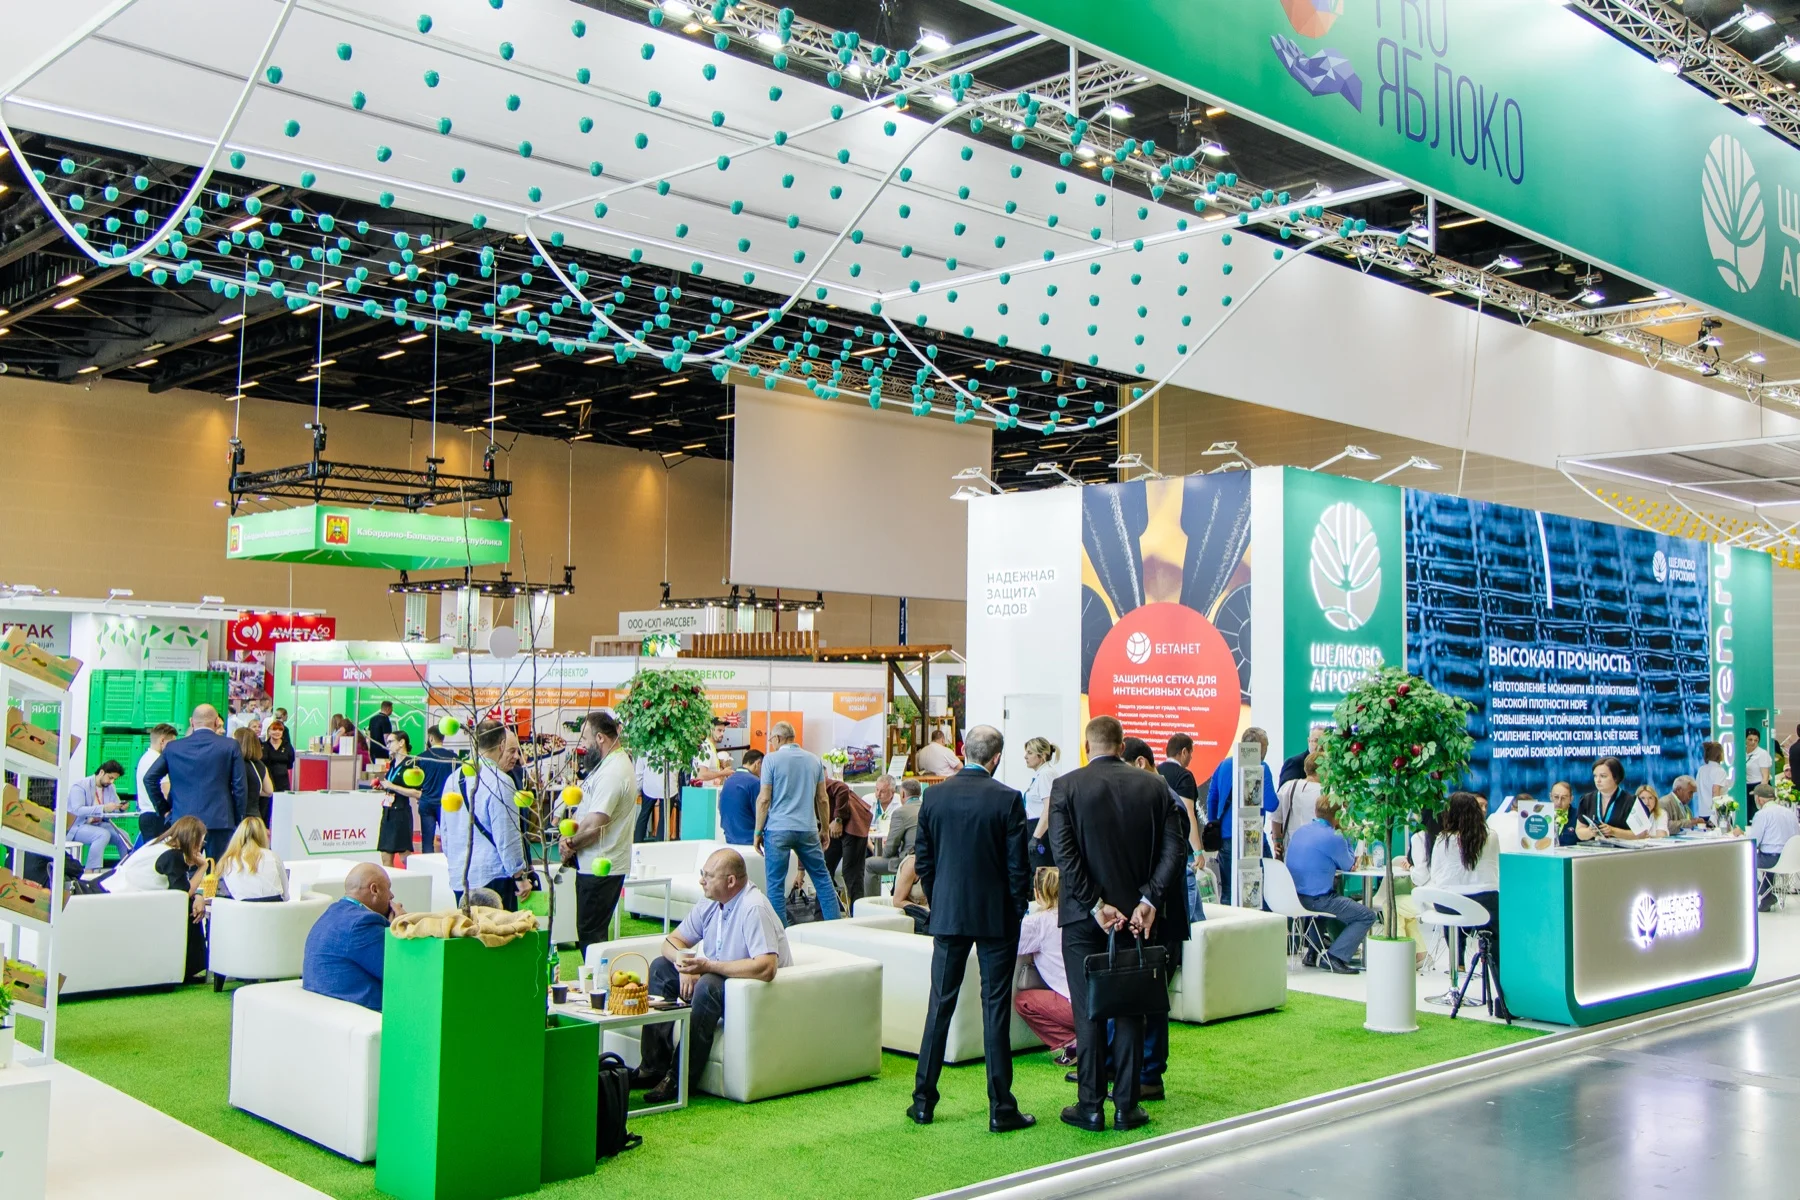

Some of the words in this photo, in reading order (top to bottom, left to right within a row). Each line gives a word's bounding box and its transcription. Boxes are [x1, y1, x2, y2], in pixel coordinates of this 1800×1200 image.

[1377, 37, 1524, 185] ЯБЛОКО
[1777, 184, 1800, 244] Щ
[357, 527, 454, 543] Кабардино-Балкарская
[987, 569, 1055, 584] НАДЕЖНАЯ
[986, 586, 1037, 601] ЗАЩИТА
[986, 603, 1028, 617] САДОВ
[1155, 643, 1201, 655] БЕТАНЕТ
[1311, 643, 1382, 667] ЩЕЛКОВО
[1489, 645, 1555, 669] ВЫСОКАЯ
[1558, 650, 1631, 673] ПРОЧНОСТЬ
[691, 670, 736, 680] ОВЕКТОР
[1112, 674, 1163, 686] ЗАЩИТНАЯ
[1165, 675, 1194, 685] СЕТКА
[1196, 676, 1217, 687] ДЛЯ
[1112, 686, 1181, 697] ИНТЕНСИВНЫХ
[1183, 687, 1217, 699] САДОВ
[1493, 681, 1546, 693] ИЗГОТОВЛЕНИЕ
[1548, 683, 1585, 695] МОНОНИТИ
[1586, 685, 1594, 695] ИЗ
[1595, 685, 1639, 696] ПОЛИЭТИЛЕНА
[1492, 697, 1527, 709] ВЫСОКОЙ
[1528, 699, 1569, 710] ПЛОТНОСТИ
[1570, 700, 1588, 710] HDPE
[1493, 714, 1544, 725] ПОВЫШЕННАЯ
[1545, 713, 1595, 726] УСТОЙЧИВОСТЬ
[1601, 715, 1639, 726] ИСТИРАНИЮ
[1493, 731, 1531, 742] УСИЛЕНИЕ
[1531, 731, 1572, 741] ПРОЧНОСТИ
[1573, 731, 1593, 741] СЕТКИ
[1594, 731, 1602, 741] ЗА
[1619, 730, 1639, 740] БОЛЕЕ
[1493, 745, 1529, 758] ШИРОКОЙ
[1530, 745, 1563, 758] БОКОВОЙ
[1564, 747, 1591, 757] КРОМКИ
[1598, 743, 1641, 757] ЦЕНТРАЛЬНОЙ
[1642, 745, 1660, 755] ЧАСТИ
[322, 828, 366, 840] METAK
